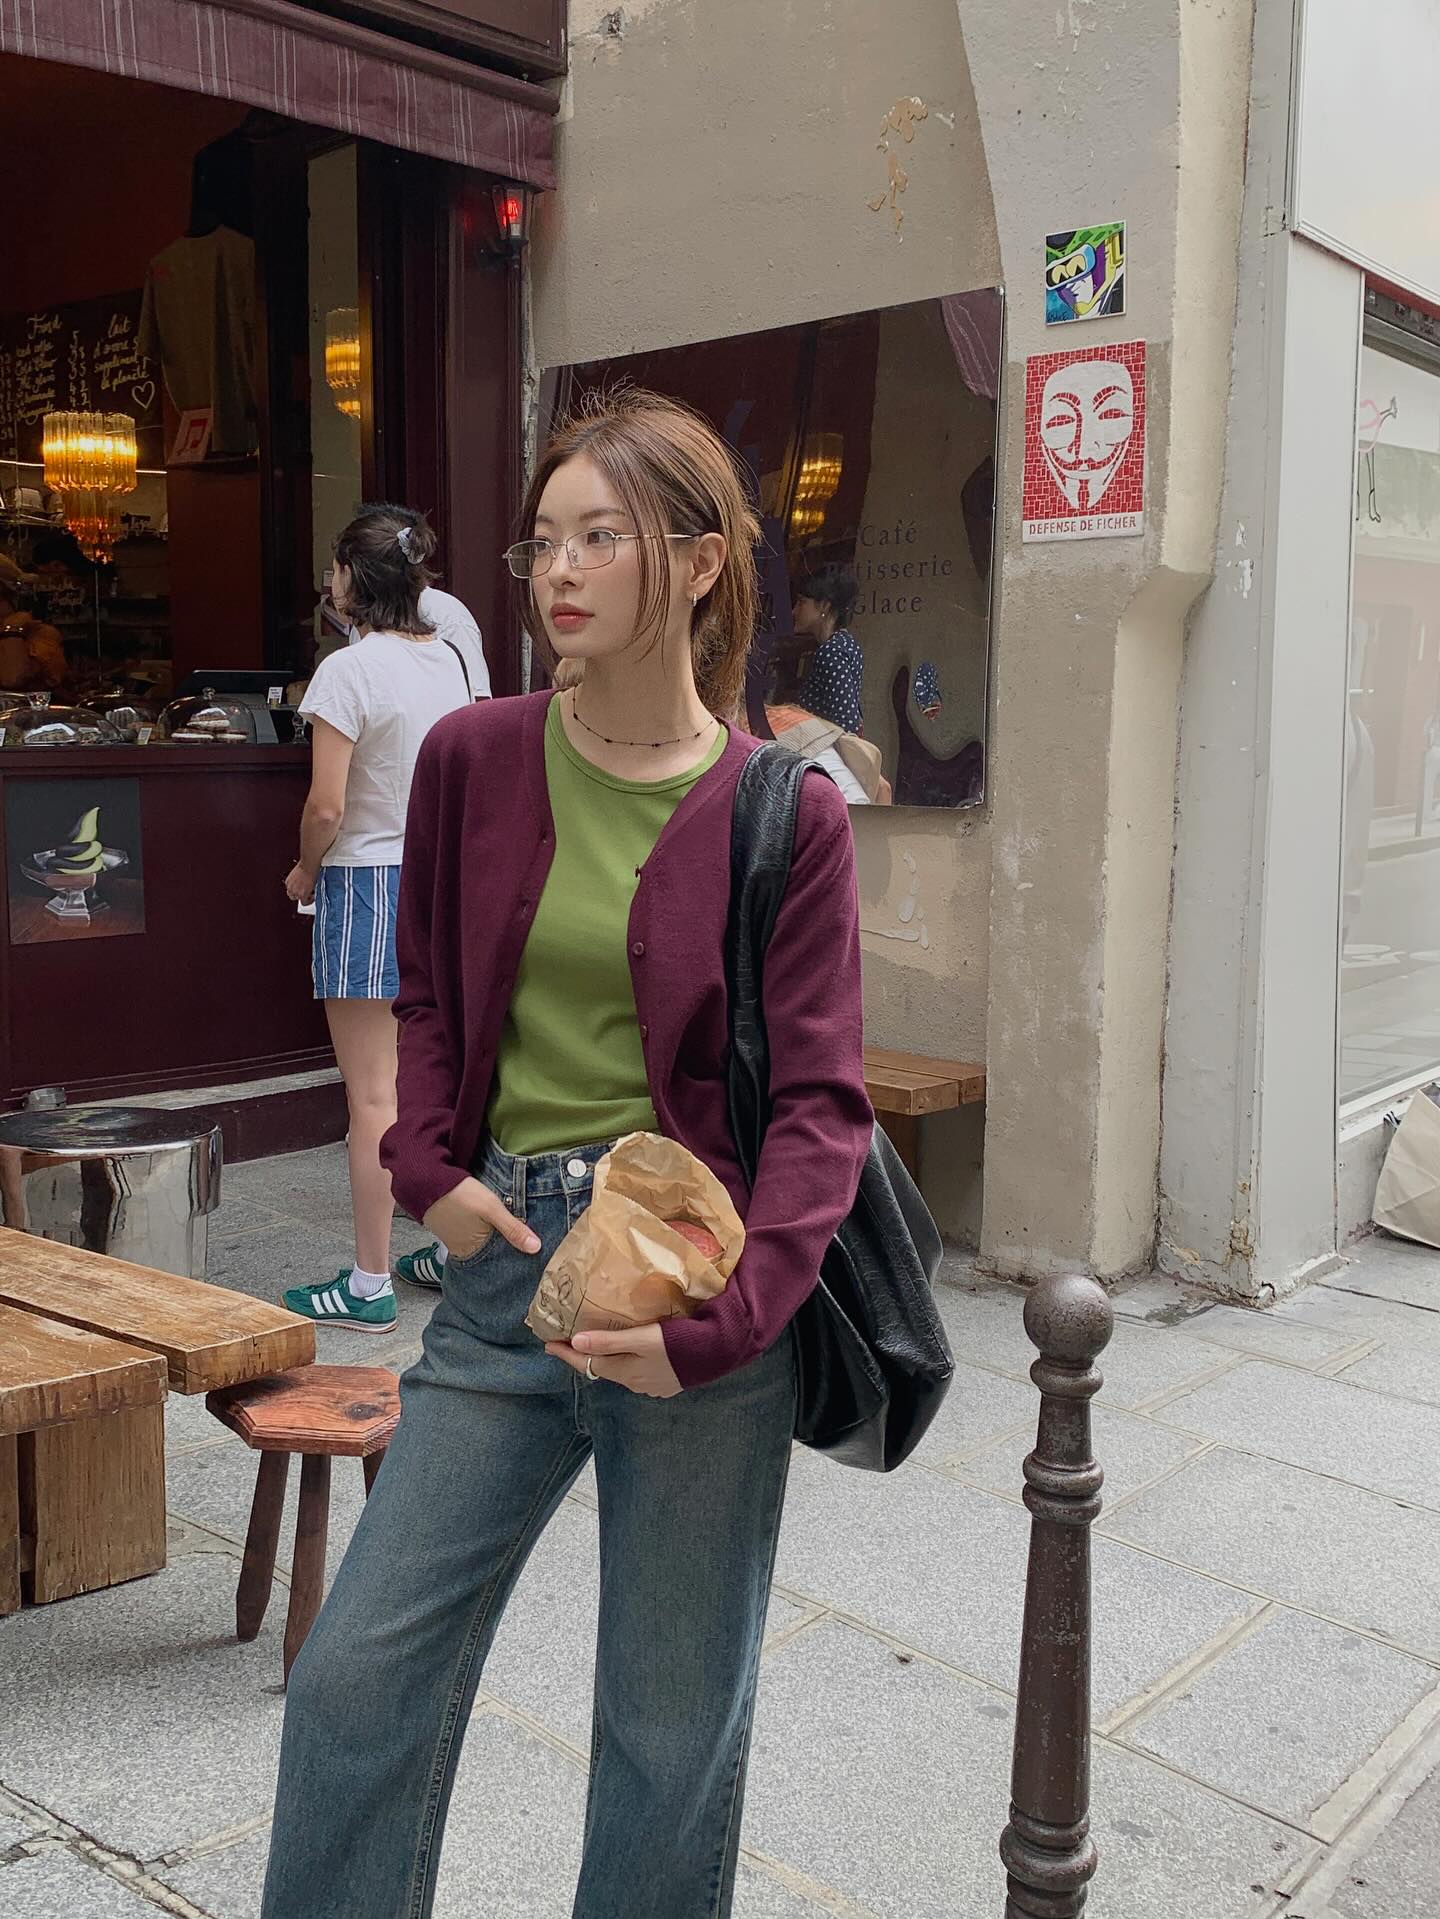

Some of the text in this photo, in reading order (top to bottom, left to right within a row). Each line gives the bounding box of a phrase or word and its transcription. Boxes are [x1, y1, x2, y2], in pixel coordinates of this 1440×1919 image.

[860, 519, 917, 547] Café
[1029, 516, 1137, 535] DEFENSE DE FICHER
[842, 554, 953, 580] tisserie
